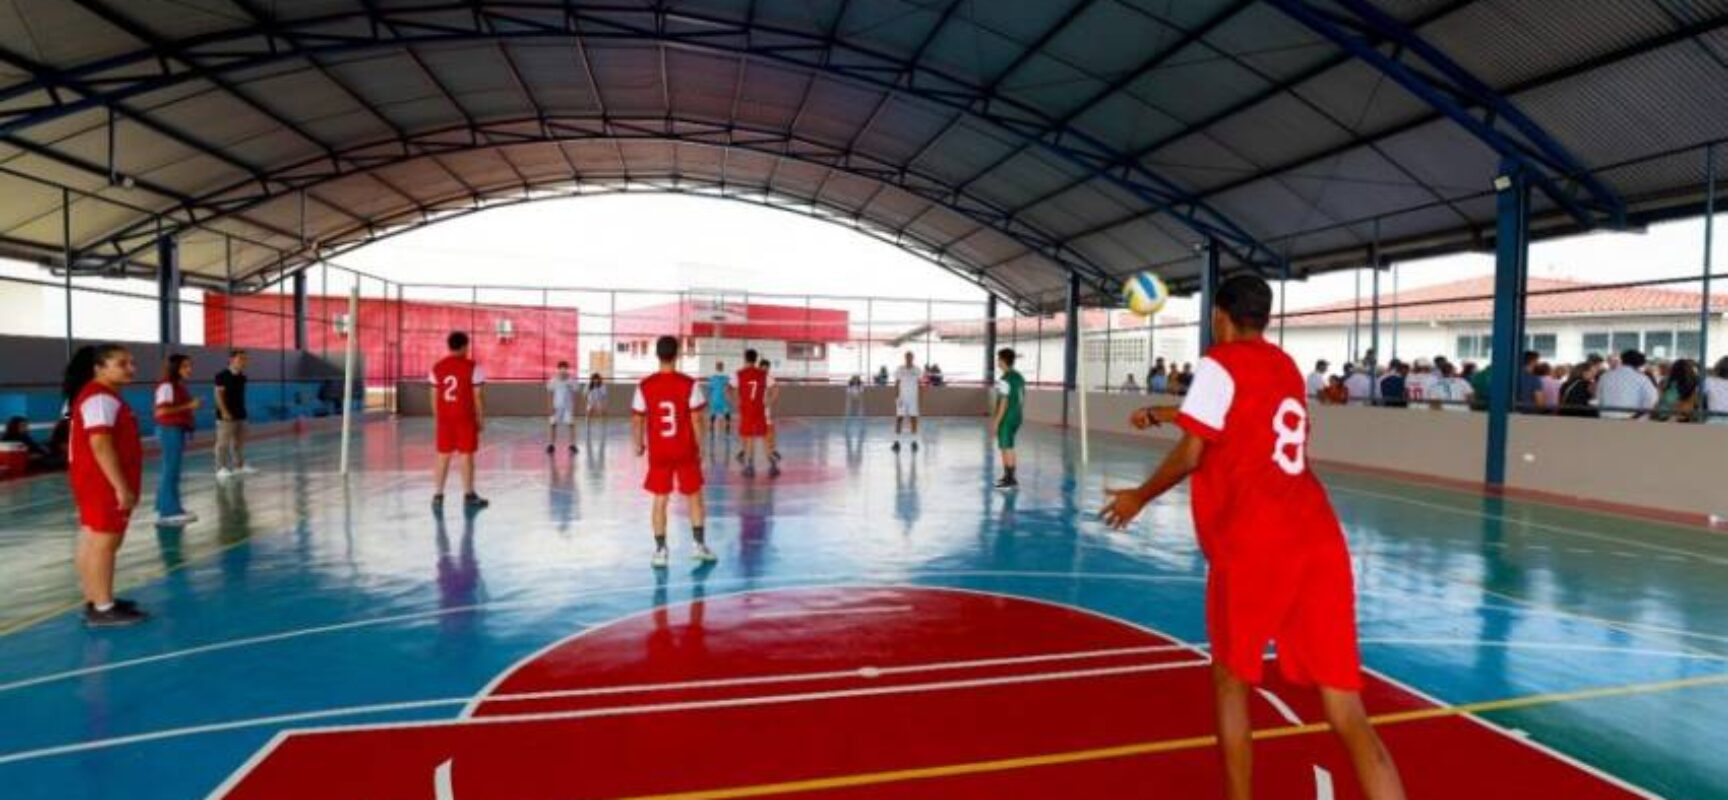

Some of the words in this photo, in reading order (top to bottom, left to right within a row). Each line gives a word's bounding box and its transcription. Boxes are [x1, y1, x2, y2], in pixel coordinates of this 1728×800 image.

[443, 375, 458, 401] 2
[747, 380, 757, 400] 7
[659, 401, 677, 437] 3
[1272, 397, 1306, 475] 8
